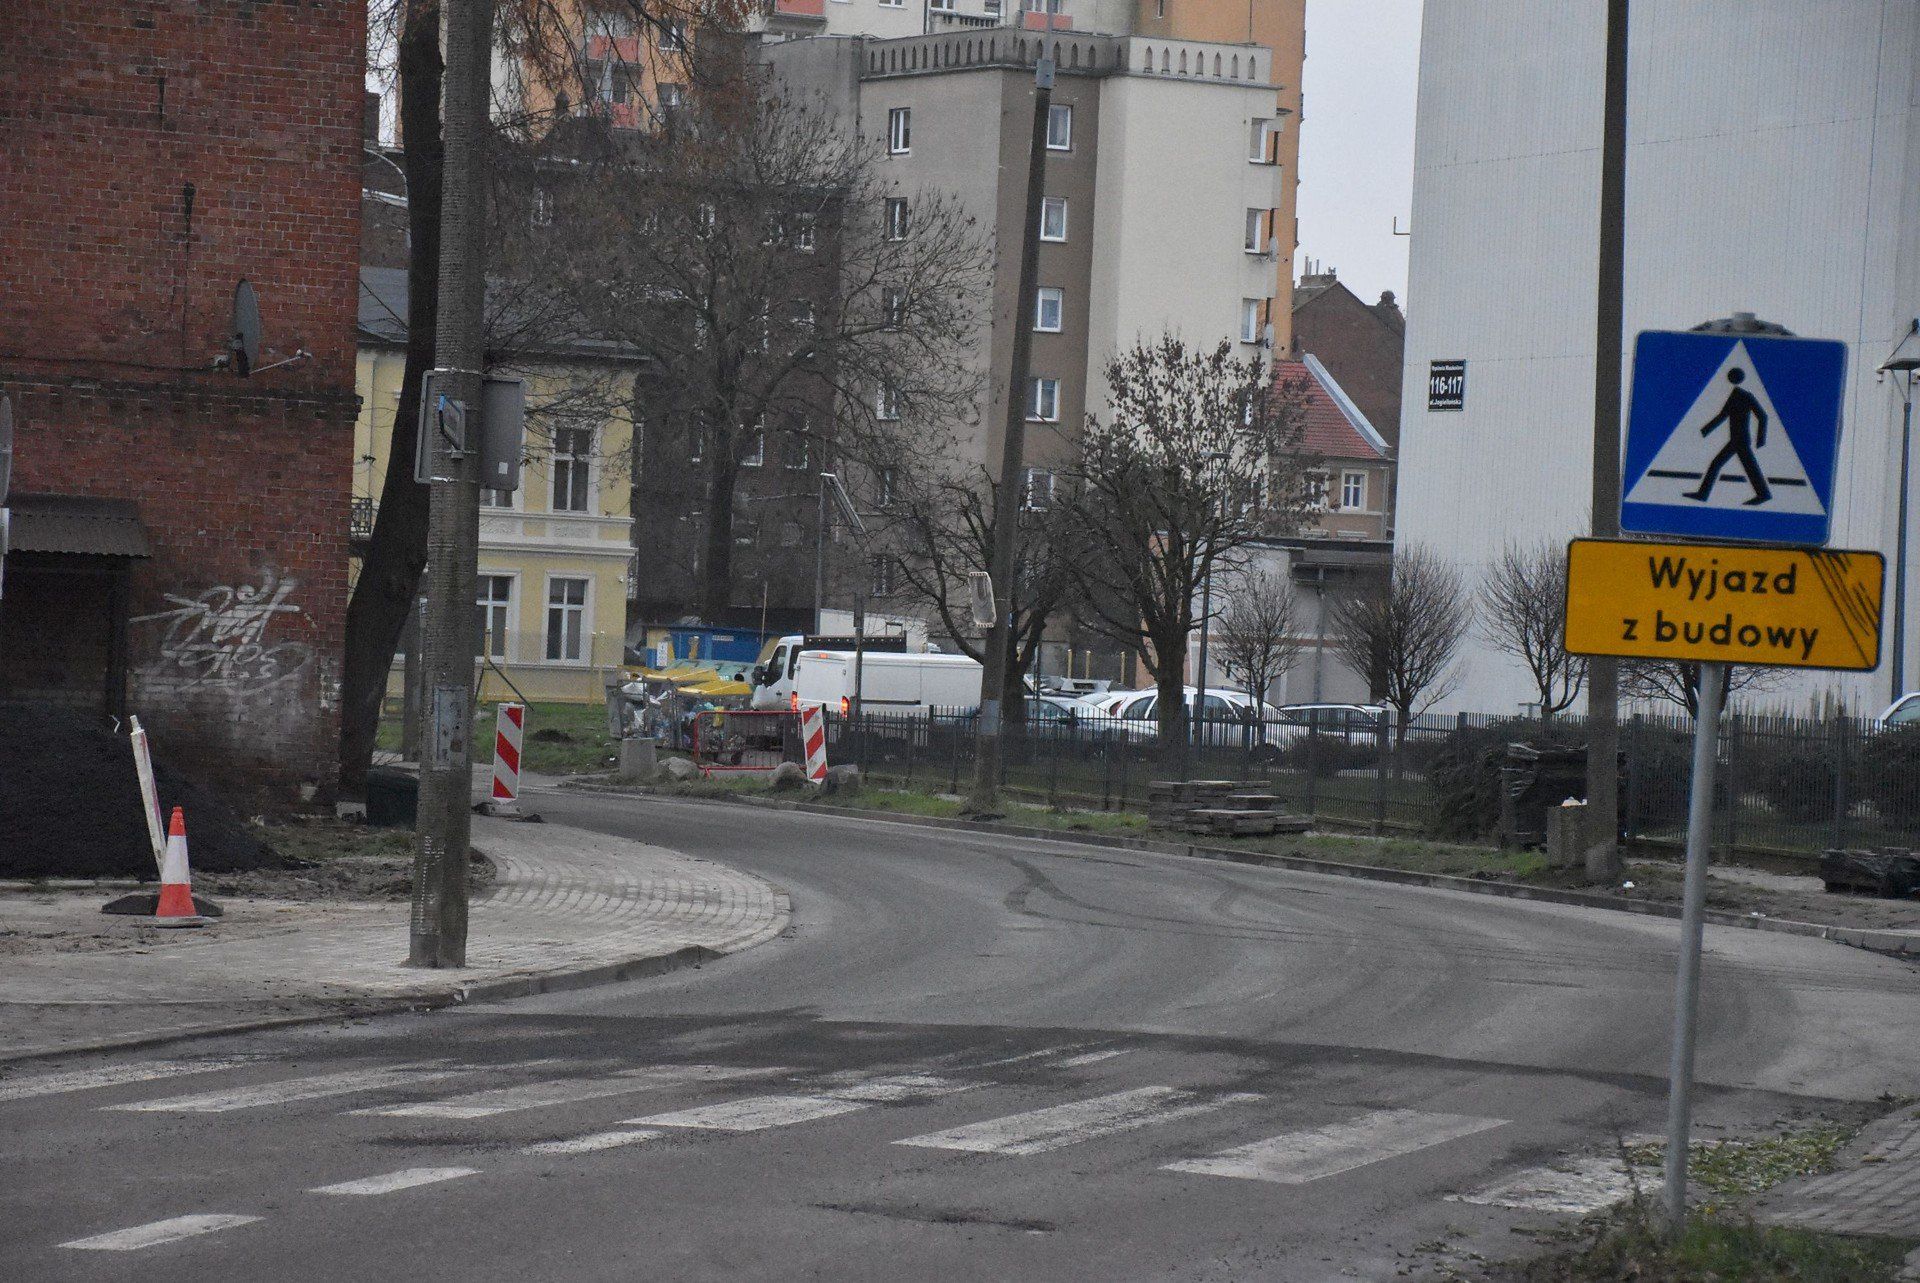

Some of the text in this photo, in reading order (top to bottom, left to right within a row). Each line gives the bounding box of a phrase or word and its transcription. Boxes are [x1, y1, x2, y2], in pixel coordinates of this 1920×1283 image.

[1430, 376, 1463, 394] 116-117
[1649, 555, 1798, 601] Wyjazd
[1621, 610, 1819, 660] z budowy
